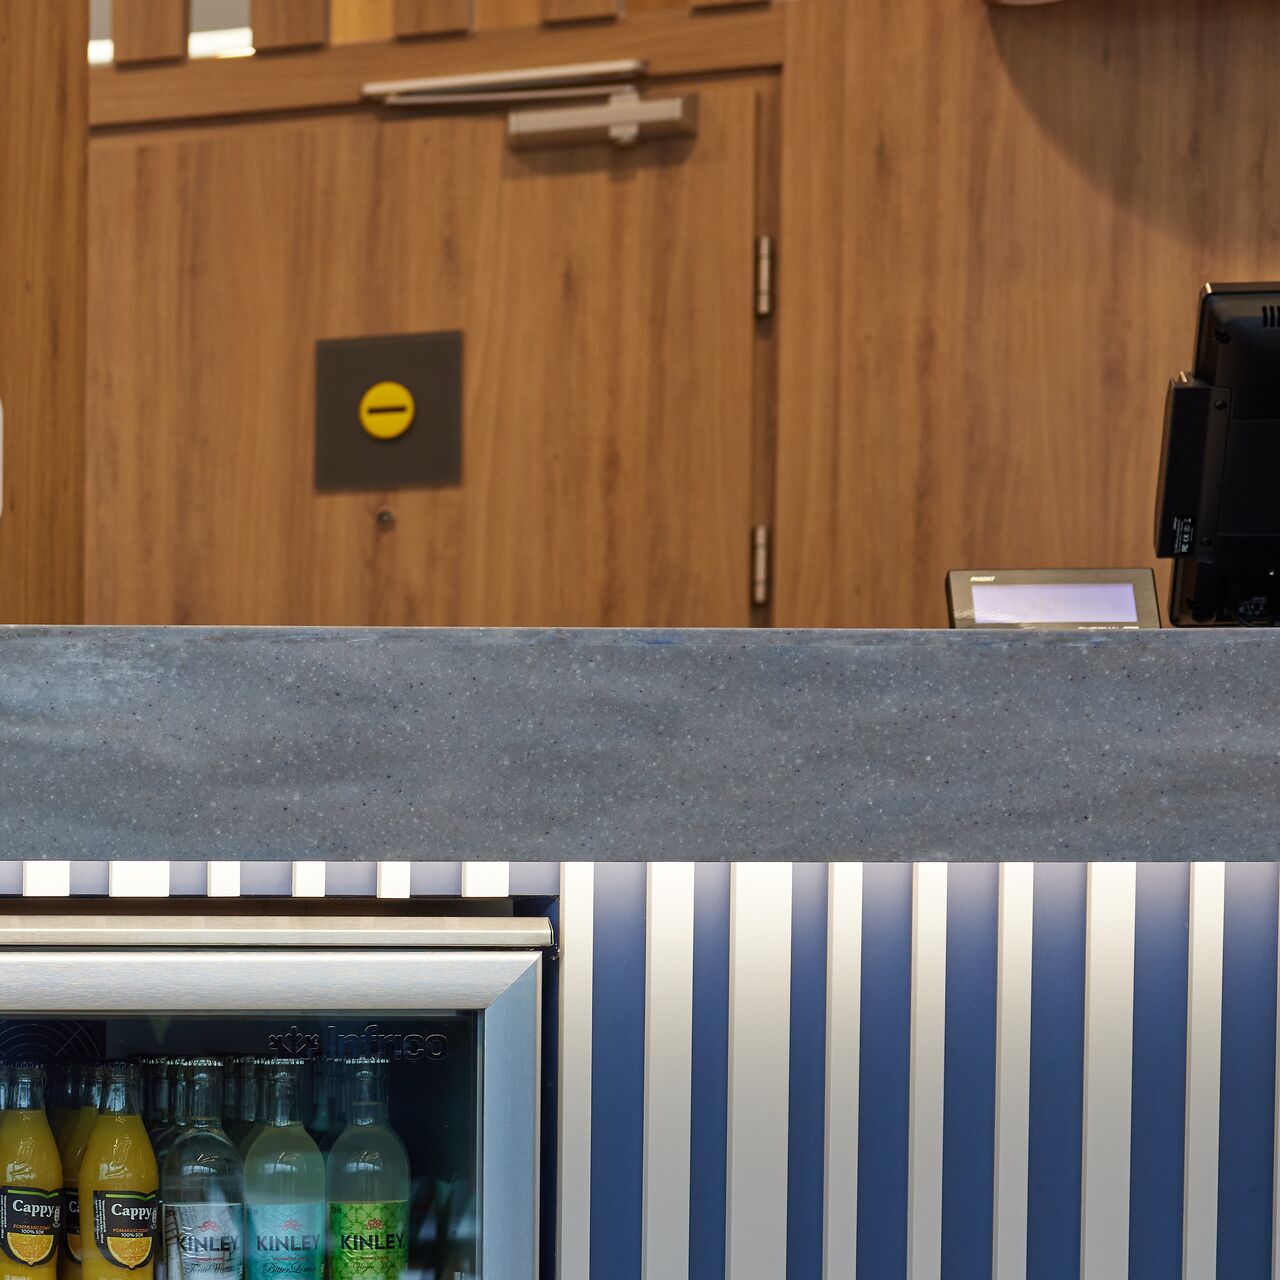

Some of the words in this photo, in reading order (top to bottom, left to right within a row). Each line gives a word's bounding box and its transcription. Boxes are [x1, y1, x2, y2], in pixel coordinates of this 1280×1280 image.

[12, 1199, 55, 1217] Cappy
[110, 1203, 153, 1220] Cappy
[176, 1234, 239, 1252] KINLEY
[256, 1234, 321, 1252] KINLEY
[341, 1233, 404, 1252] KINLEY
[263, 1262, 290, 1274] Bitter
